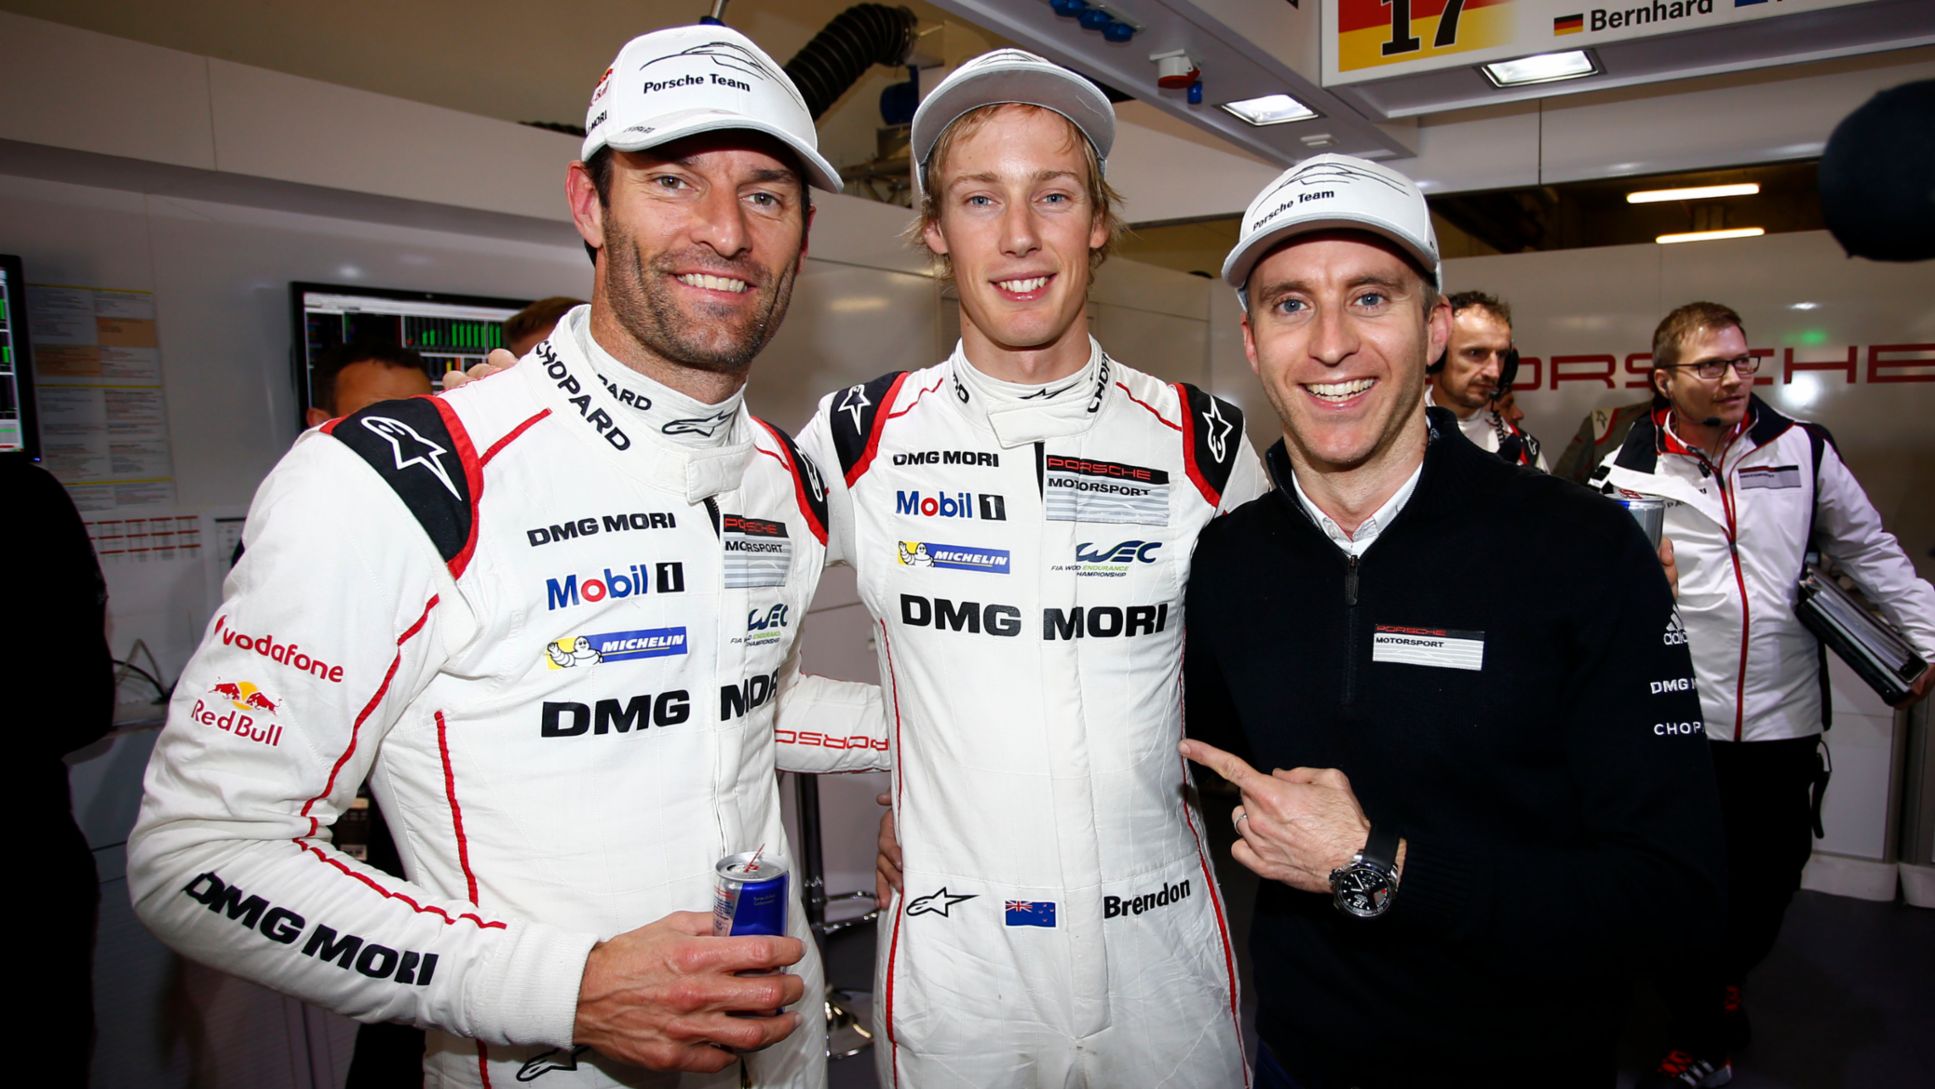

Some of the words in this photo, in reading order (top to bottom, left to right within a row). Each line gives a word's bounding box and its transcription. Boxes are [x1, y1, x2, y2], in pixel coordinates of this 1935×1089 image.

[1381, 0, 1465, 56] 17
[1591, 0, 1713, 32] Bernhard
[643, 74, 704, 94] Porsche
[709, 73, 751, 92] Team
[1252, 199, 1294, 232] Porsche
[1298, 189, 1335, 203] Team
[535, 340, 631, 451] CHOPARD
[893, 451, 940, 466] DMG
[943, 451, 999, 467] MORI
[1047, 457, 1151, 480] PORSCHE
[896, 490, 973, 518] Mobil
[526, 518, 599, 547] DMG
[603, 512, 677, 533] MORI
[933, 550, 1008, 567] MICHELIN
[1076, 540, 1162, 563] WEC
[546, 564, 649, 610] Mobil
[748, 603, 788, 630] WEC
[900, 594, 1022, 637] DMG
[1043, 604, 1168, 641] MORI
[1375, 625, 1447, 636] PORSCHE
[222, 627, 344, 683] vodafone
[601, 633, 685, 653] MICHELIN
[1376, 637, 1444, 647] MOTORSPORT
[1650, 678, 1689, 694] DMG
[191, 699, 236, 731] Red
[234, 715, 283, 746] Bull
[541, 689, 691, 738] DMG
[180, 871, 305, 944] DMG
[1104, 879, 1191, 919] Brendon
